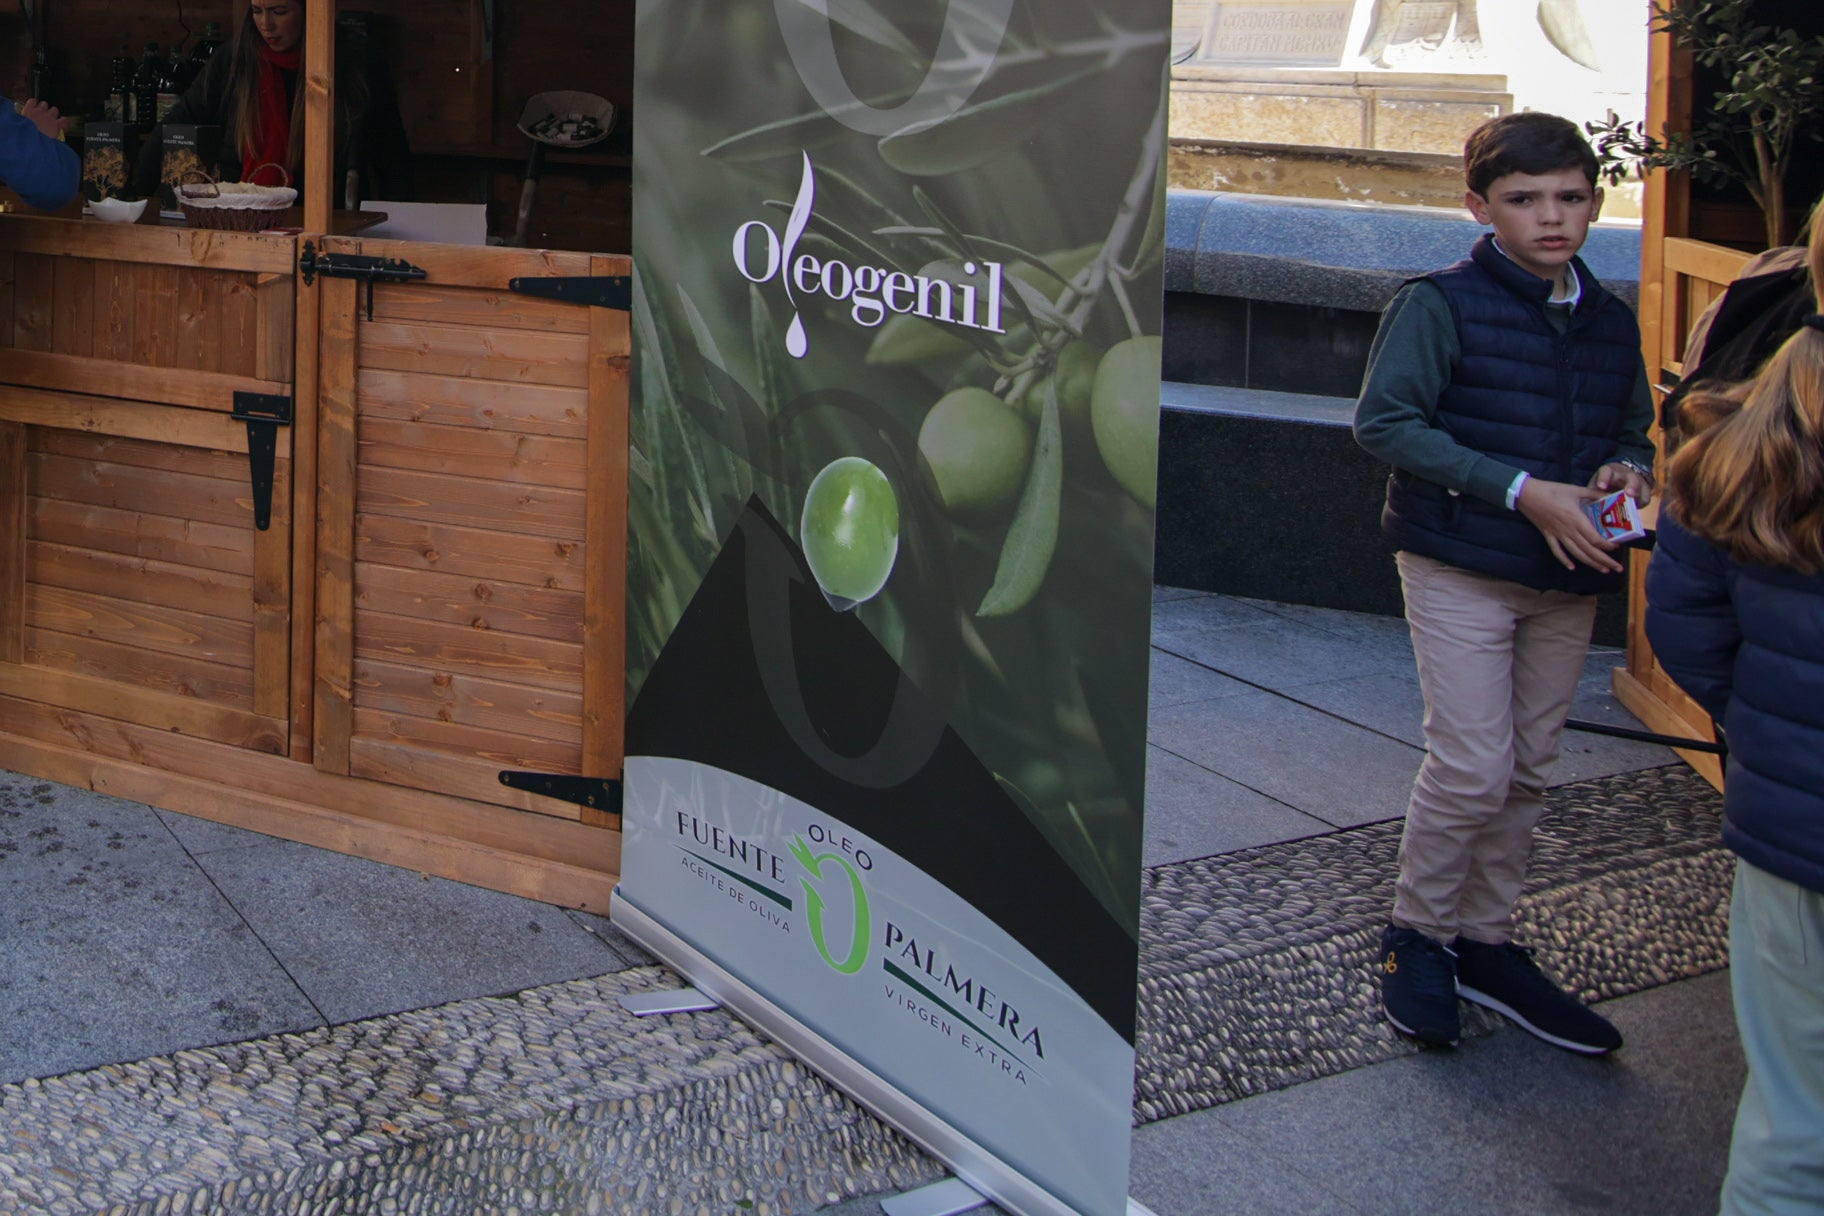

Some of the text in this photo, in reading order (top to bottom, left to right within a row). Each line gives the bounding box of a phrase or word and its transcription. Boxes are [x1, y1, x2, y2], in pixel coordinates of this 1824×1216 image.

[733, 149, 1007, 335] Oleogenil
[680, 856, 791, 934] ACEITE DE OLIVA
[808, 823, 874, 872] OLEO
[676, 811, 1045, 1060] FUENTE PALMERA
[884, 985, 1027, 1086] VIRGEN EXTRA
